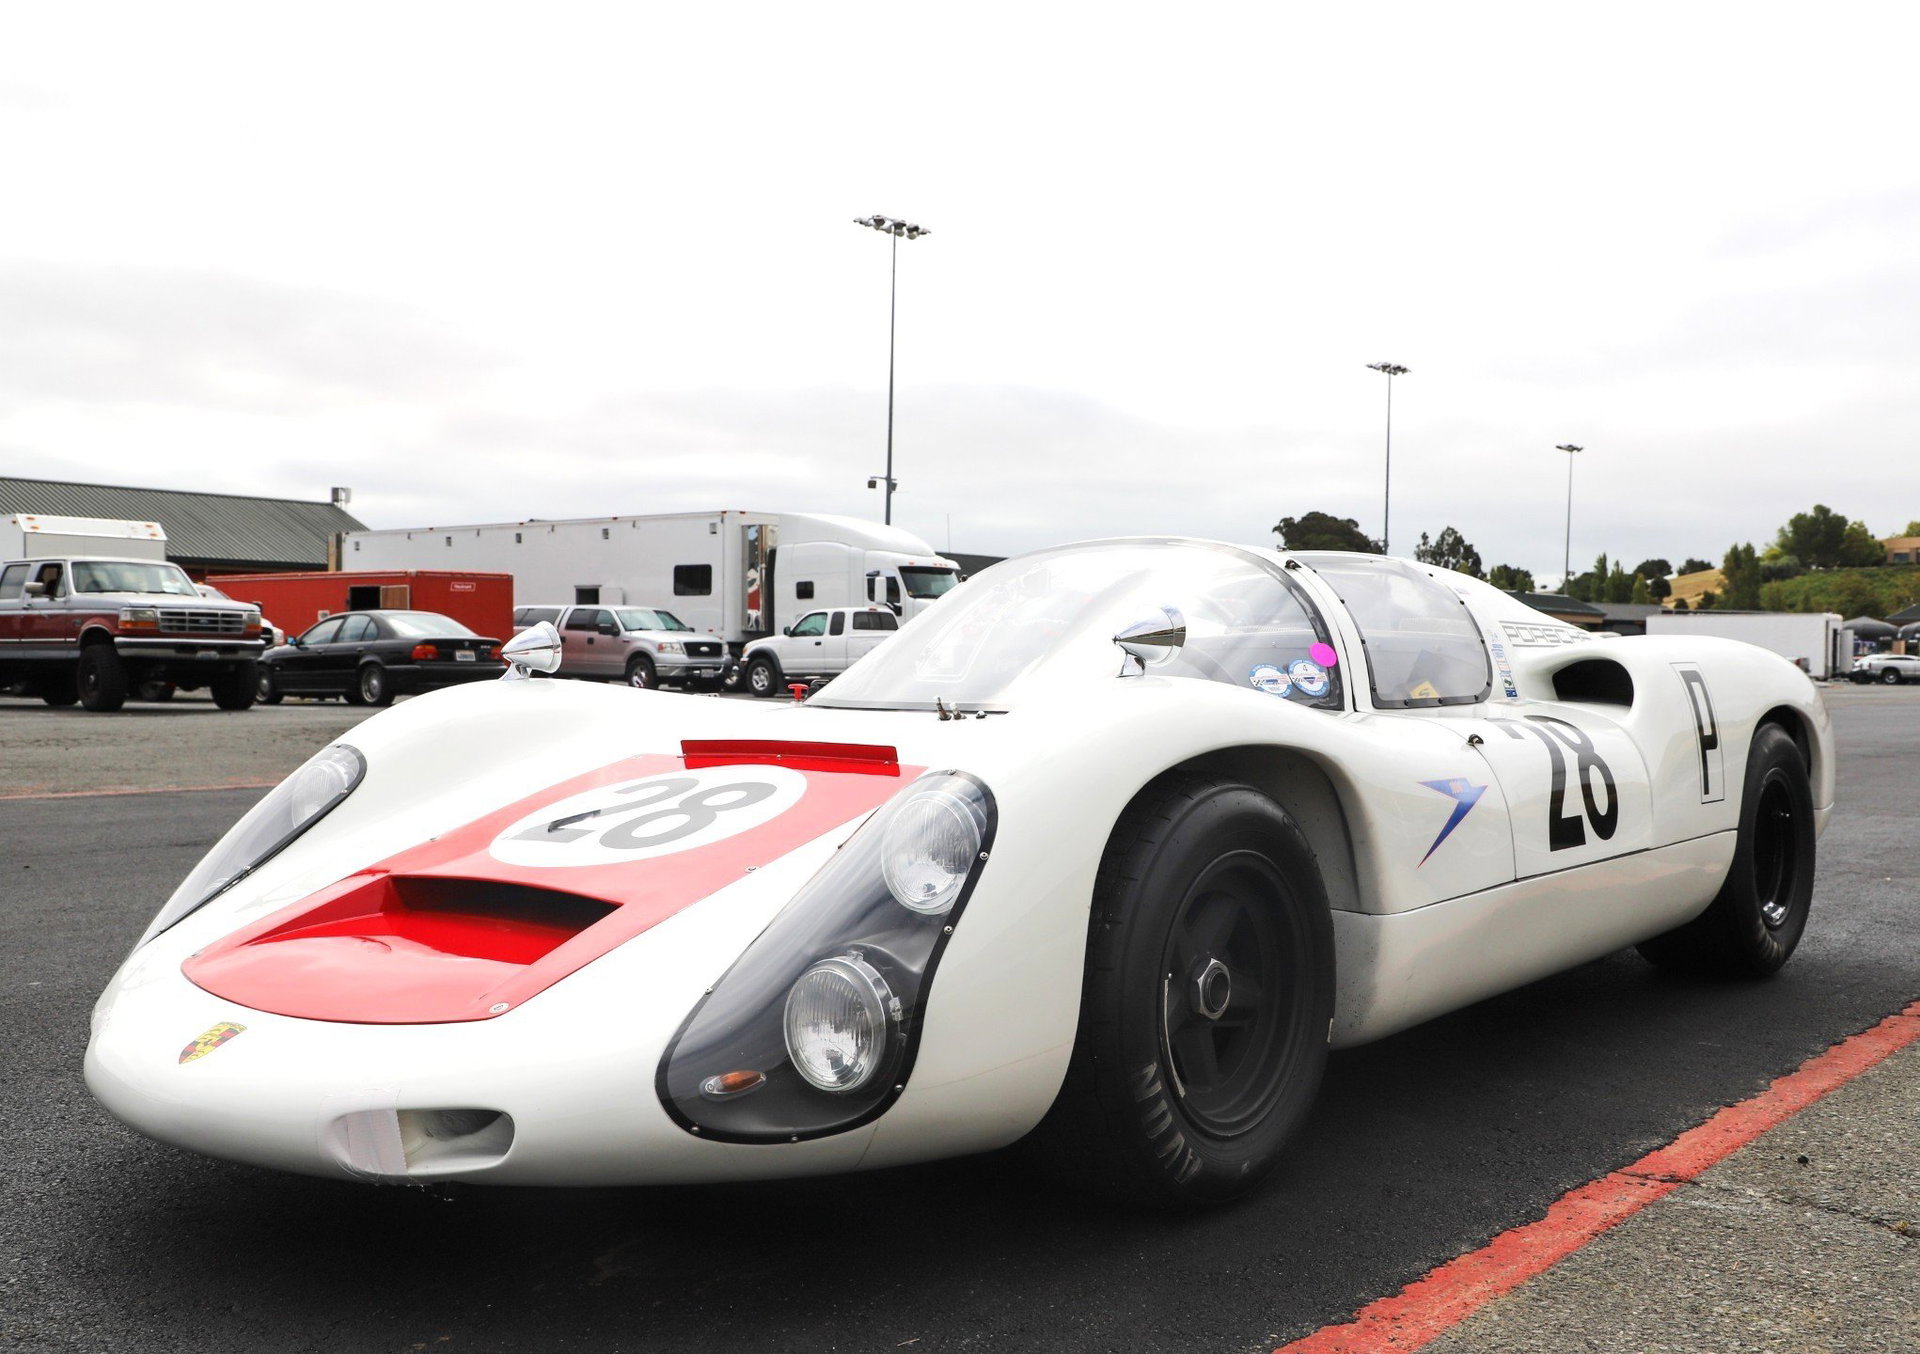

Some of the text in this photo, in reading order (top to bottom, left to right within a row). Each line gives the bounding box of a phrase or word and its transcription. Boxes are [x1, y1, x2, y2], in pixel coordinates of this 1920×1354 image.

[508, 777, 778, 850] 28
[1484, 714, 1618, 852] 28
[1135, 1061, 1202, 1184] AVON
